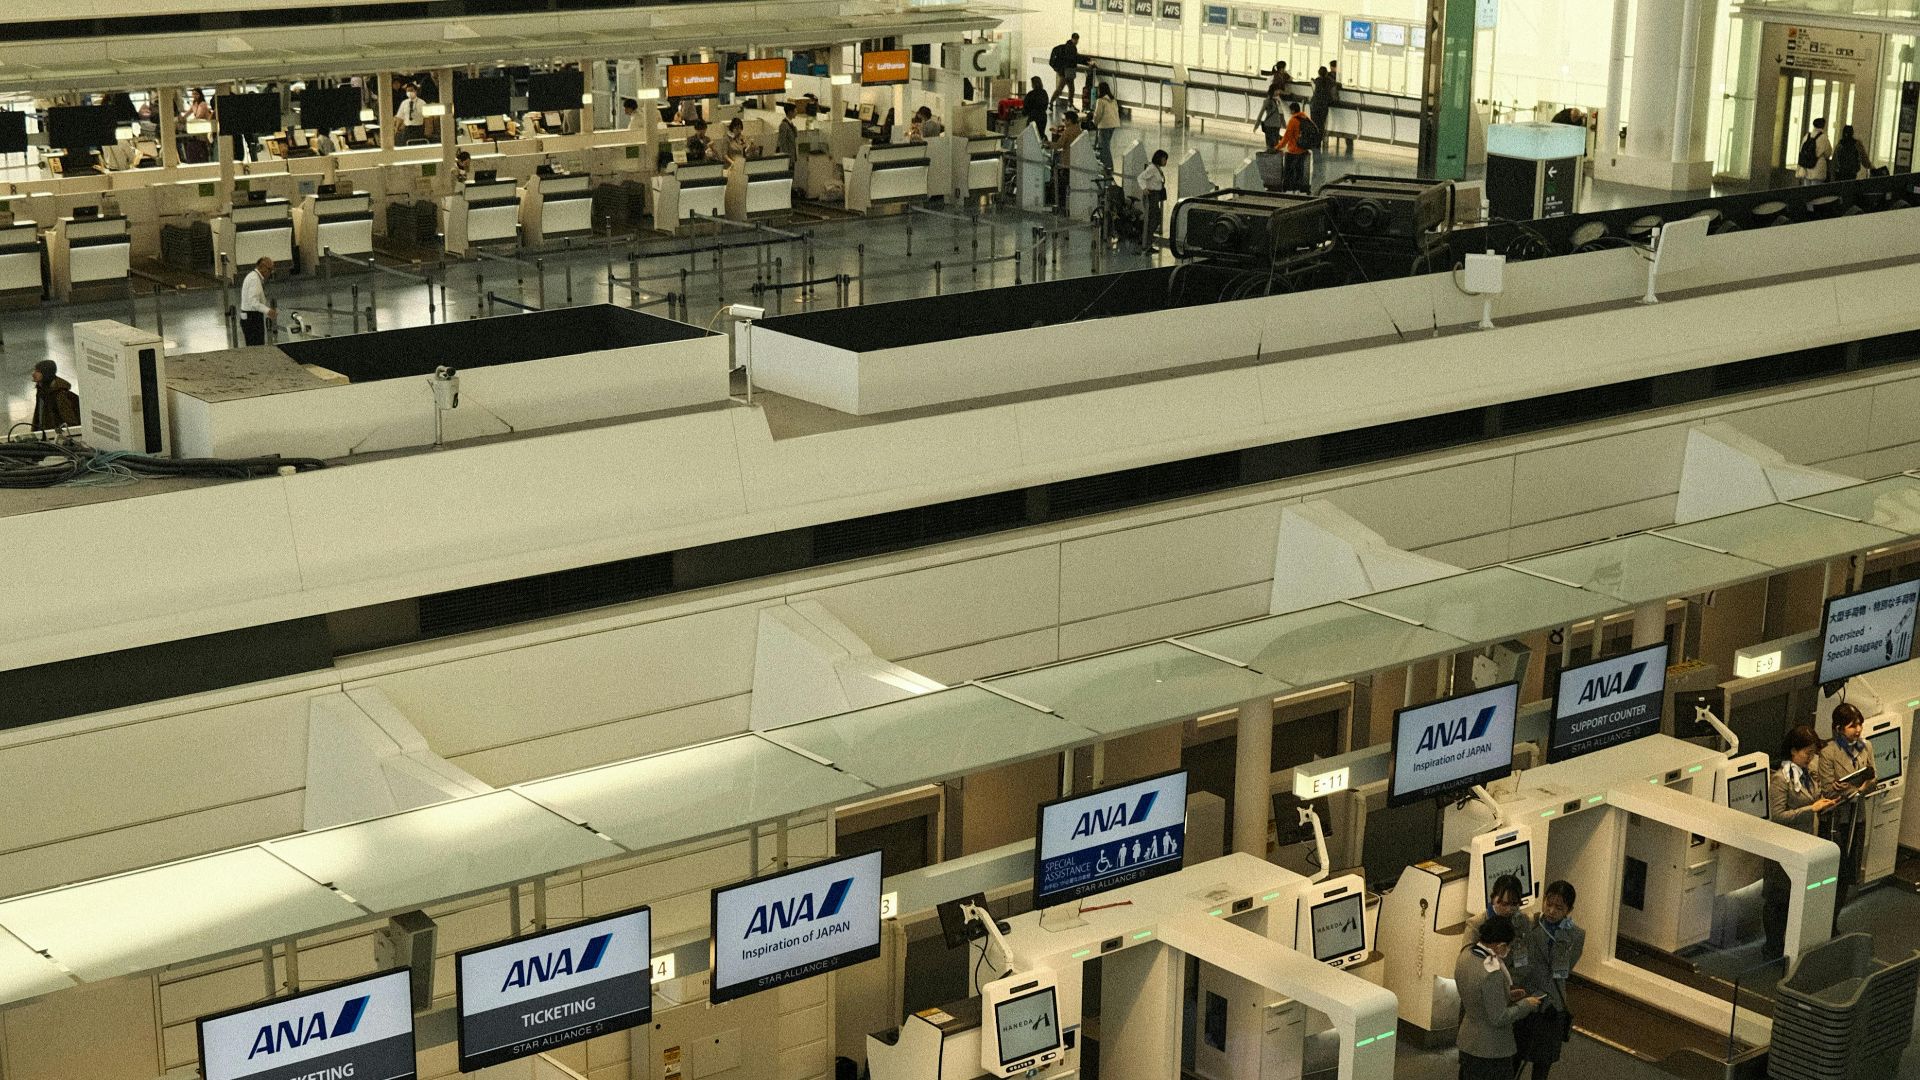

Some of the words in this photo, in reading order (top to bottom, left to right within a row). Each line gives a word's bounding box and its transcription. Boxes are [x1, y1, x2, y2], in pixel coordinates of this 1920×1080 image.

[877, 61, 905, 70] Lufthansa
[973, 49, 987, 71] C
[684, 75, 714, 84] Lufthansa
[752, 71, 782, 80] Lufthansa
[1829, 626, 1865, 644] Oversized
[1827, 645, 1853, 662] Special
[1853, 639, 1883, 654] Baggage
[1756, 657, 1774, 673] E-9
[1577, 671, 1623, 705] ANA
[1571, 714, 1608, 734] SUPPORT
[1609, 704, 1647, 723] COUNTER
[1415, 716, 1467, 754] ANA
[1571, 740, 1592, 753] STAR
[1594, 729, 1632, 746] ALLIANCE
[1413, 754, 1455, 772] Inspiration
[1456, 750, 1466, 761] of
[1466, 742, 1492, 758] JAPAN
[1313, 774, 1344, 793] E-11
[1071, 802, 1127, 840] ANA
[1044, 862, 1091, 883] ASSISTANCE
[1045, 857, 1076, 872] SPECIAL
[1075, 883, 1096, 895] STAR
[1097, 871, 1137, 889] ALLIANCE
[743, 892, 814, 939] ANA
[742, 937, 800, 960] Inspiration
[802, 929, 814, 943] of
[815, 920, 850, 940] JAPAN
[500, 947, 573, 992] ANA
[758, 973, 782, 987] STAR
[784, 961, 828, 979] ALLIANCE
[521, 997, 596, 1027] TICKETING
[247, 1011, 328, 1060] ANA
[1003, 1018, 1034, 1032] HANEDA
[513, 1040, 539, 1054] STAR
[542, 1025, 592, 1046] ALLIANCE
